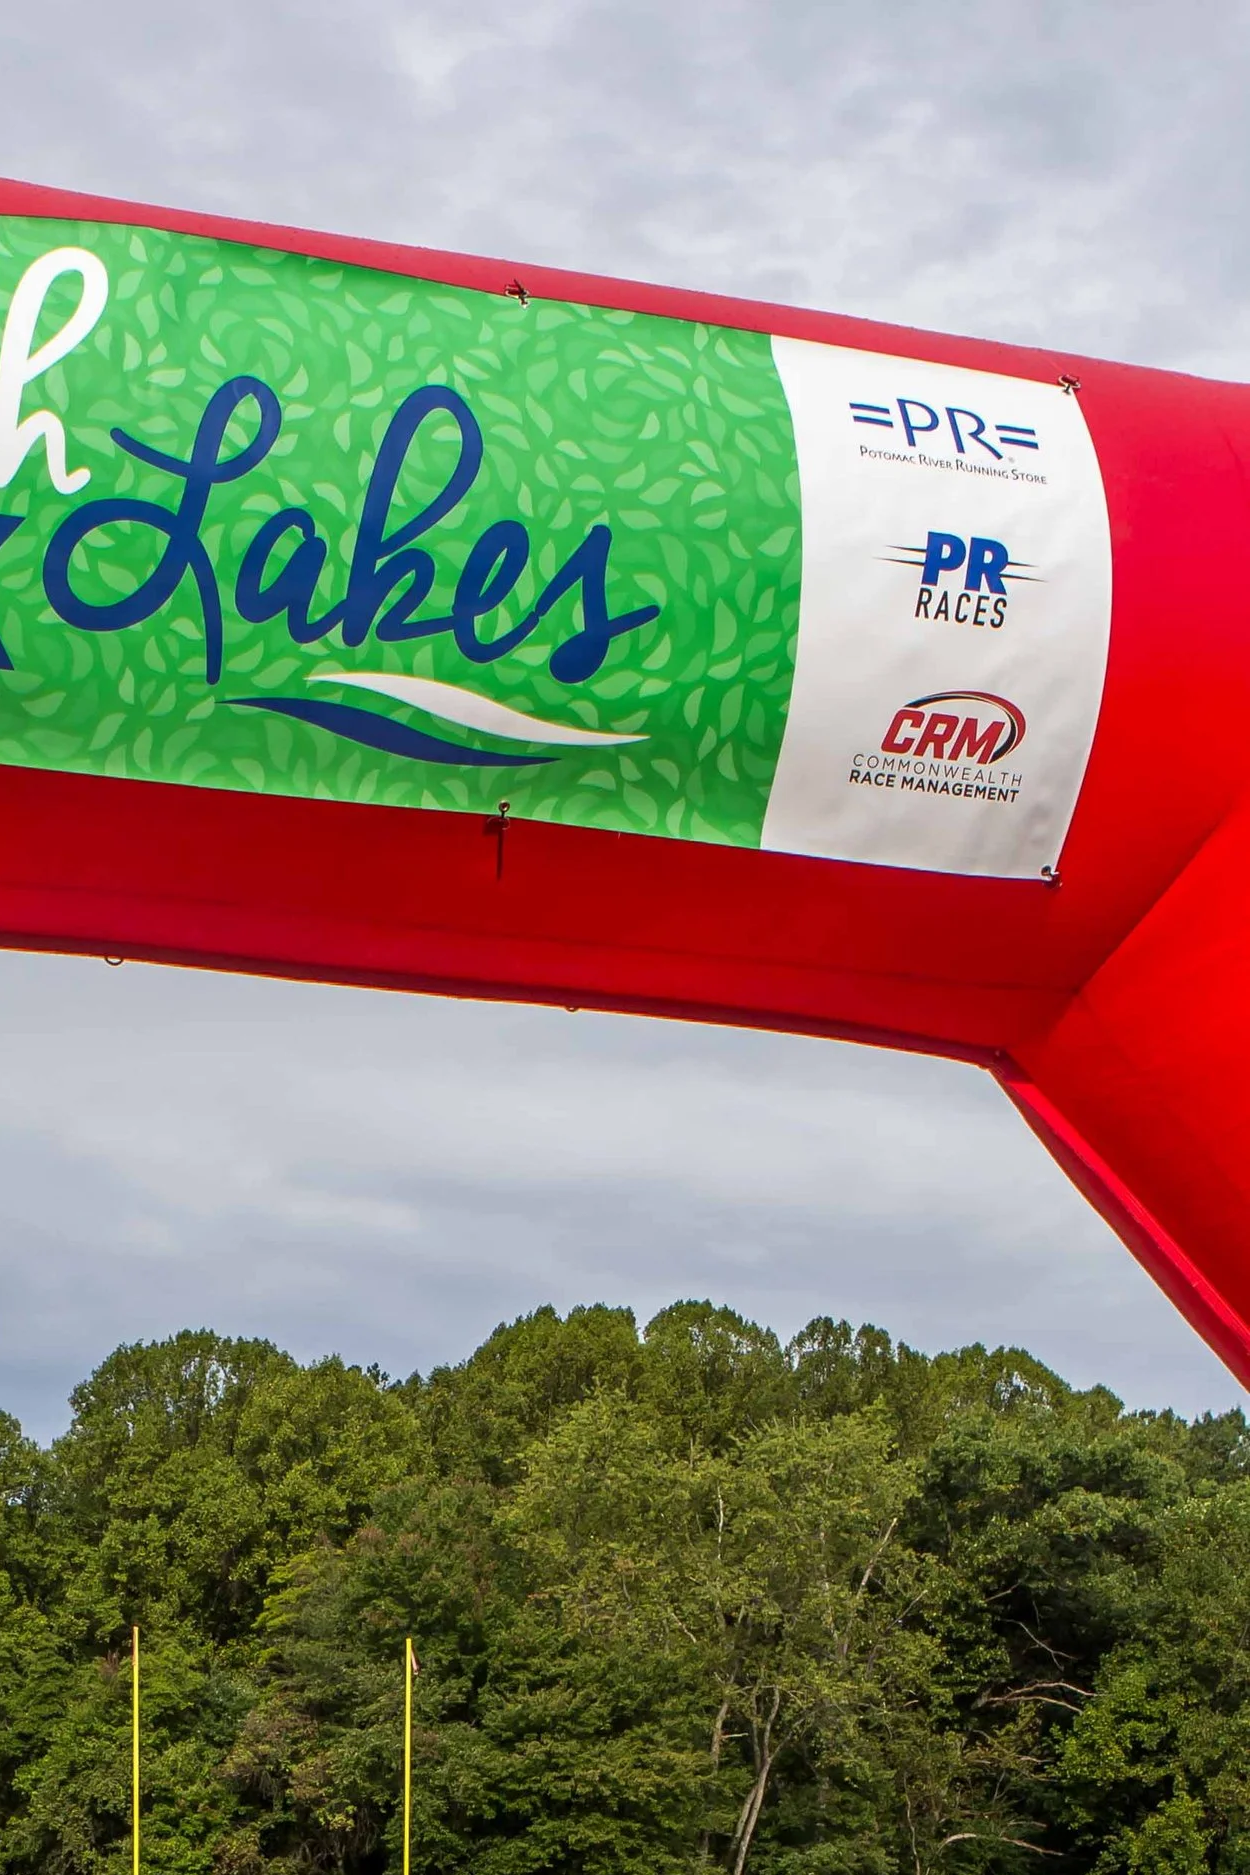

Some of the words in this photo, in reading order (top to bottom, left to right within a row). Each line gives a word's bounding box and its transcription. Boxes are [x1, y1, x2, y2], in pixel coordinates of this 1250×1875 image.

[42, 375, 660, 685] Lakes
[920, 530, 1009, 596] PR
[914, 586, 1008, 629] RACES
[880, 708, 1006, 766] CRM
[849, 769, 897, 788] RACE
[900, 776, 1020, 803] MANAGEMENT
[852, 753, 1023, 787] COMMONWEALTH
